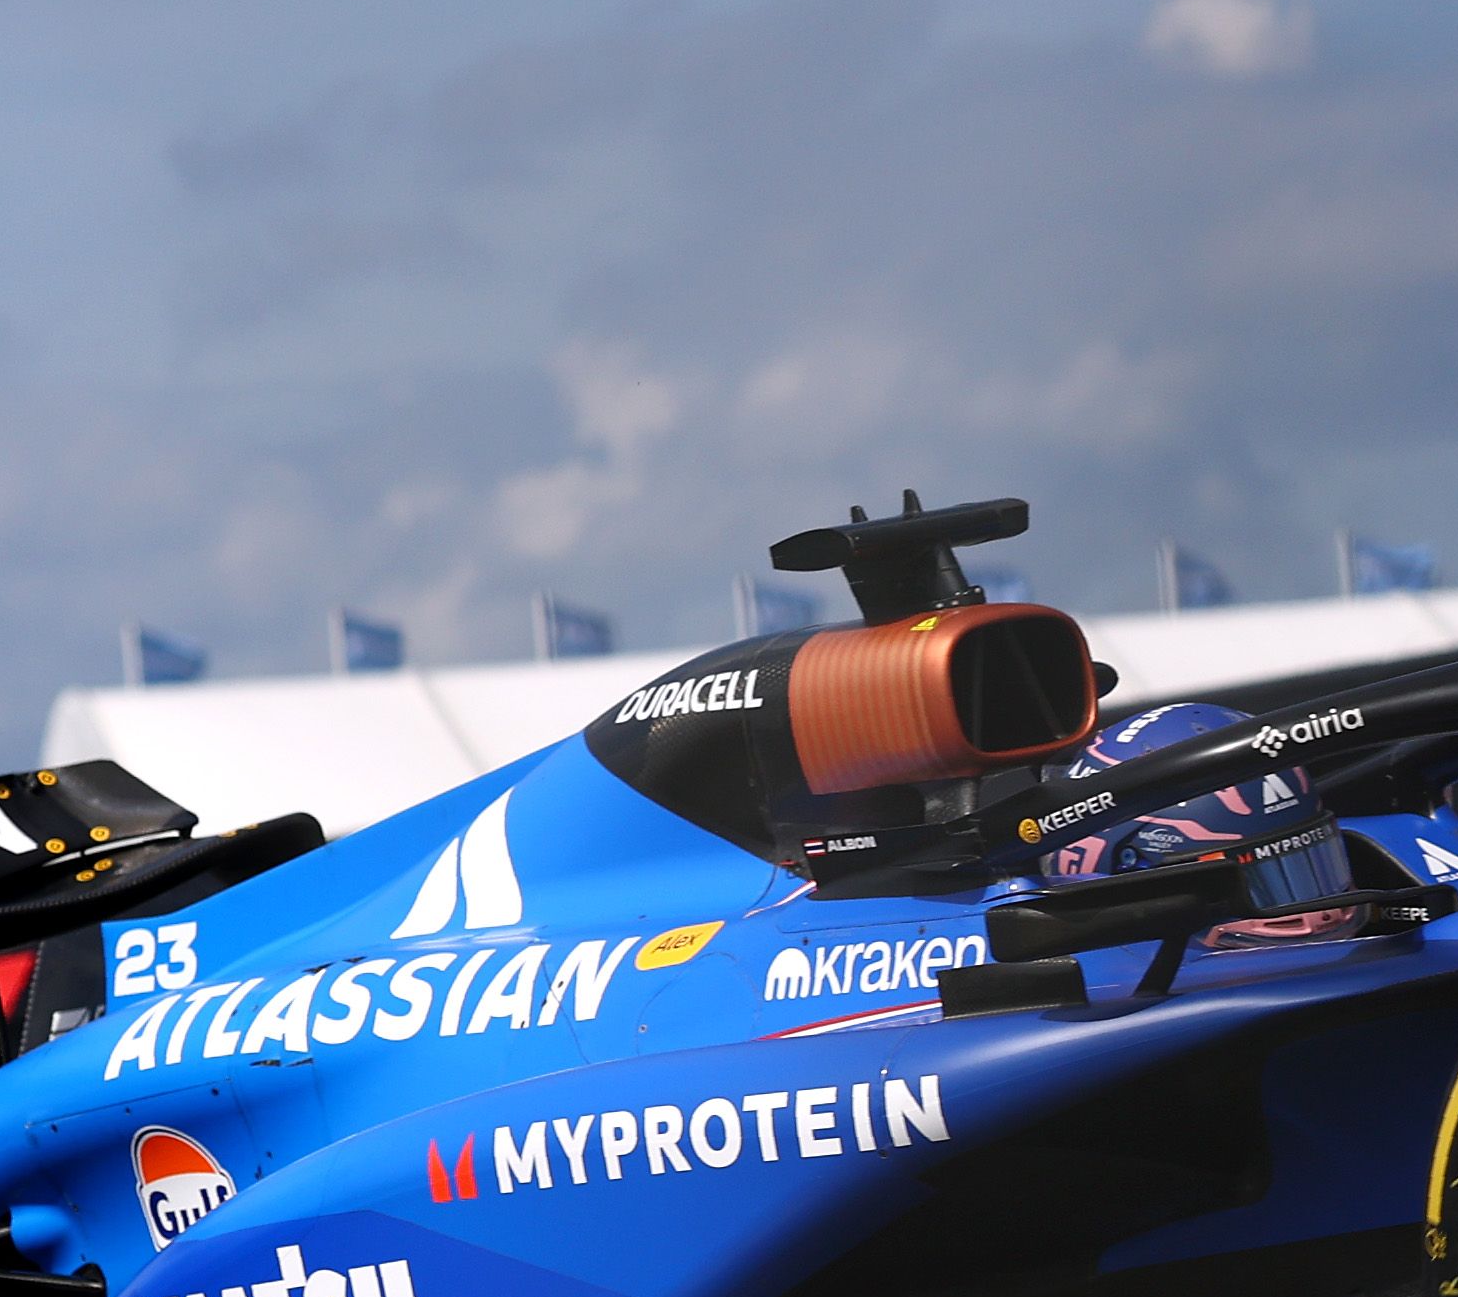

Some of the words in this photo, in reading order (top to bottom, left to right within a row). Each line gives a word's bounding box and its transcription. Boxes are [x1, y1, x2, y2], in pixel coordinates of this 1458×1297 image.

[614, 669, 765, 724] DURACELL
[1289, 707, 1365, 745] airia
[1038, 791, 1117, 834] KEEPER
[827, 835, 878, 854] ALBON
[114, 921, 199, 998] 23
[811, 934, 987, 997] kraken
[103, 936, 640, 1082] ATLASSIAN
[493, 1074, 950, 1194] MYPROTEIN
